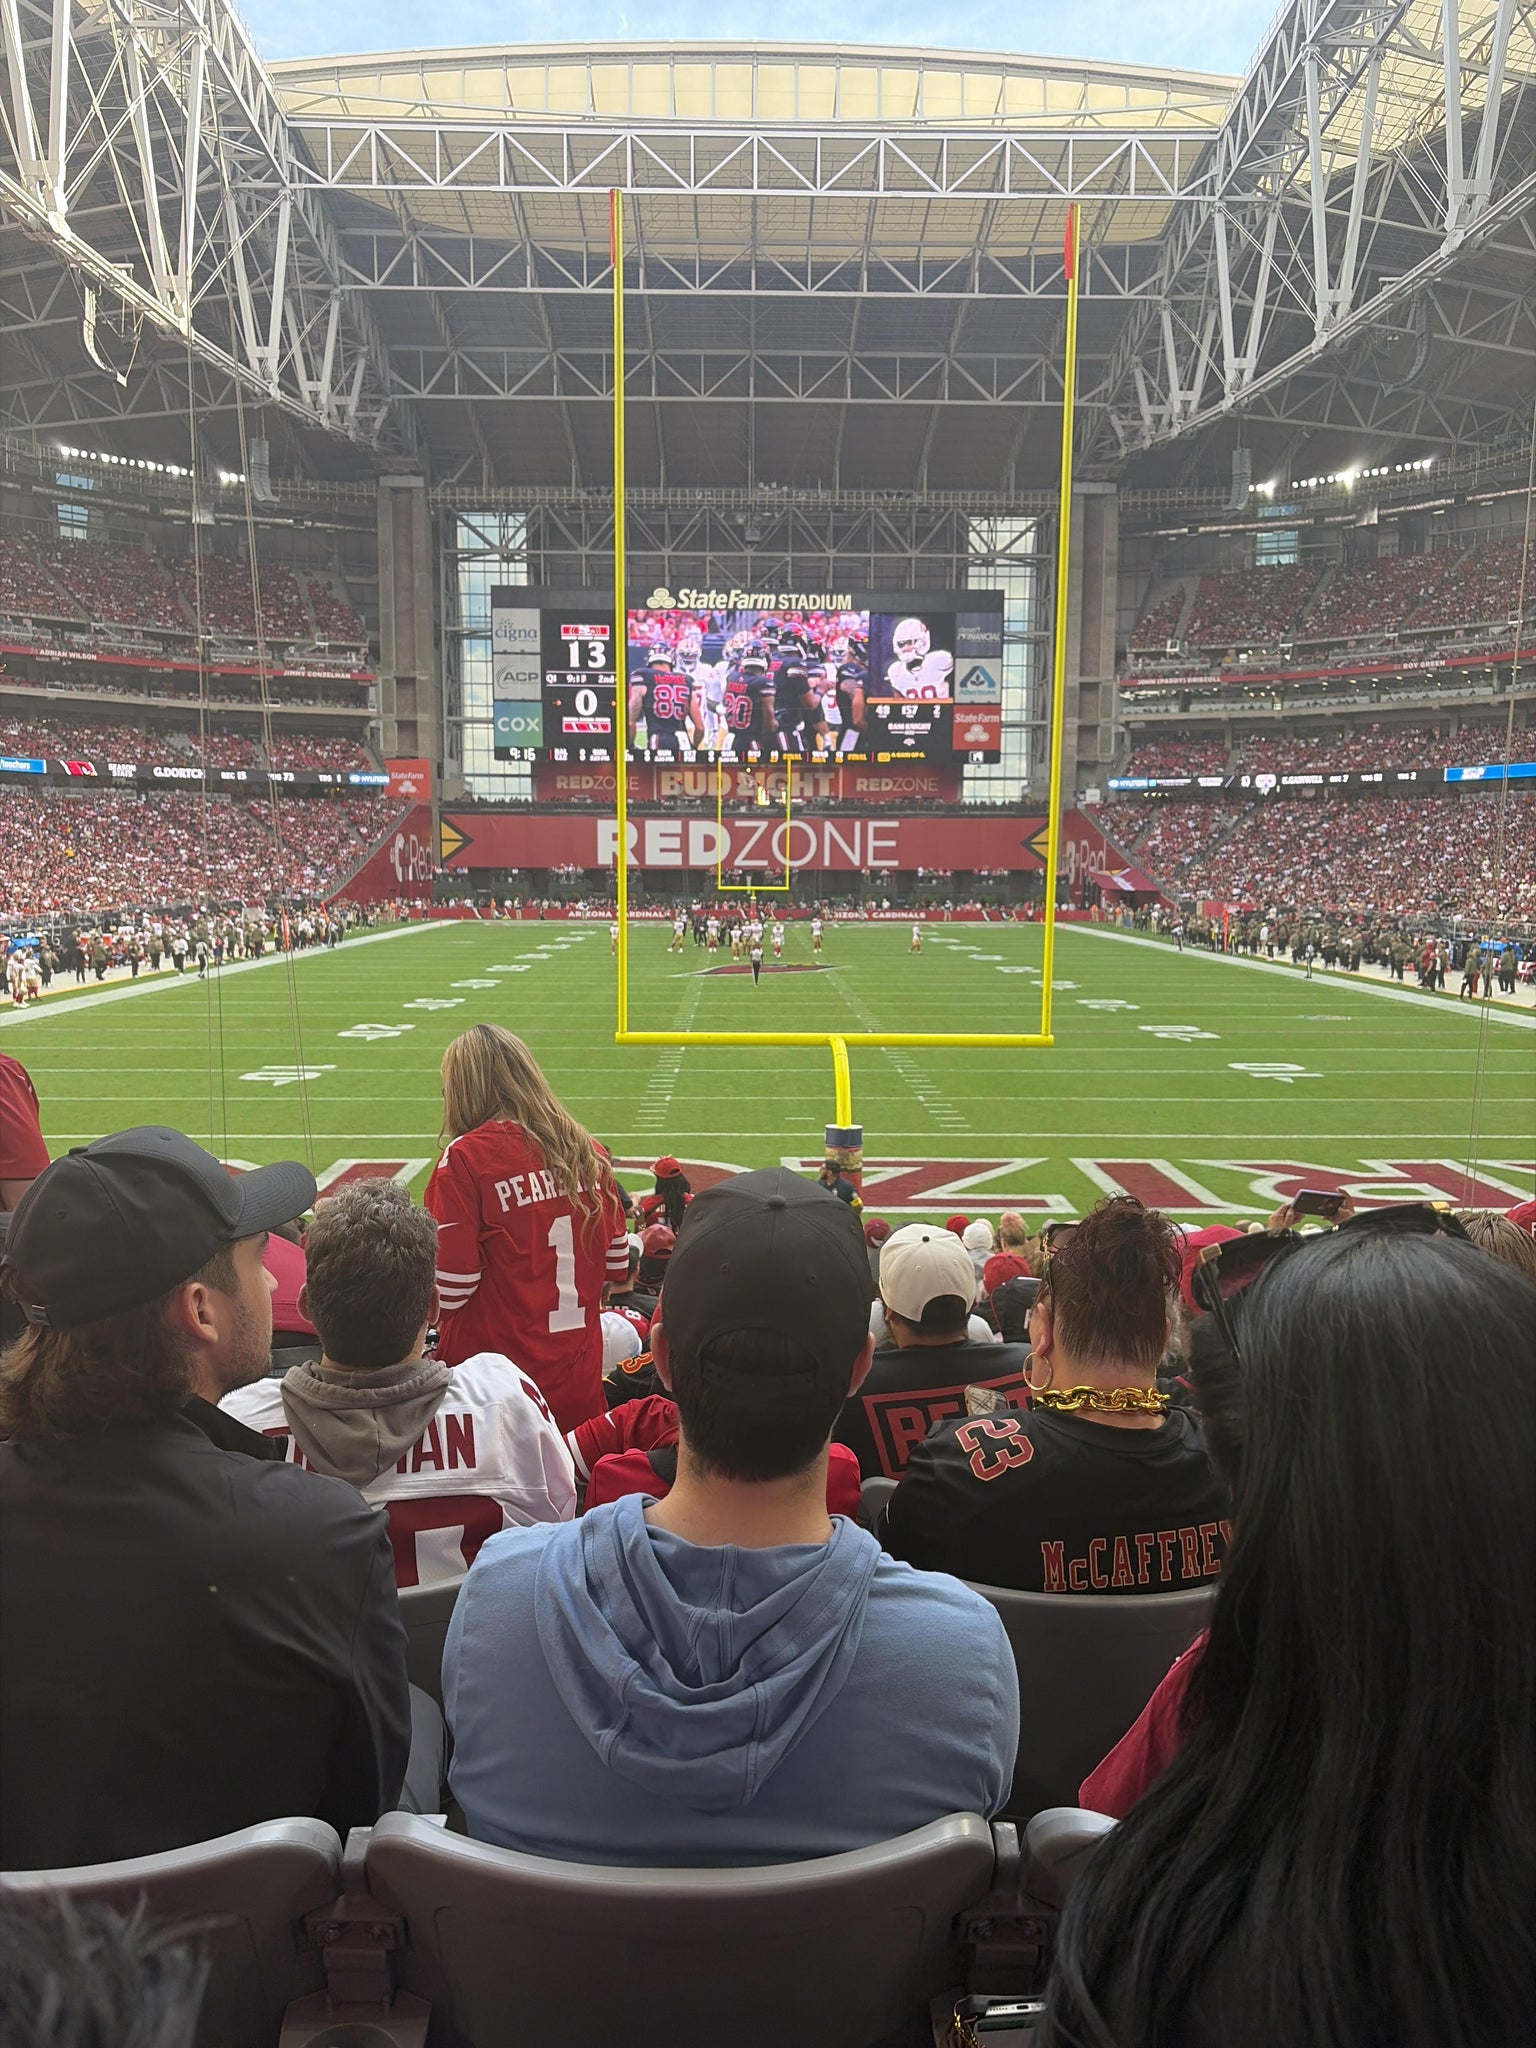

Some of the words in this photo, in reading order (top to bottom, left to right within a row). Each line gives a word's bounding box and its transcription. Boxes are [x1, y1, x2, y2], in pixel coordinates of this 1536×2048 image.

[778, 595, 852, 610] STADIUM
[495, 625, 538, 641] cigna
[40, 649, 68, 658] ADRIAN
[69, 652, 97, 660] WILSON
[568, 640, 606, 668] 13
[1403, 662, 1418, 670] ROY
[1420, 660, 1446, 668] GREEN
[284, 669, 306, 677] JIMMY
[503, 672, 539, 682] ACP
[546, 674, 557, 683] Q1
[598, 674, 615, 684] 2nd
[575, 689, 598, 717] 0
[653, 684, 690, 721] 85
[497, 717, 540, 732] COX
[108, 763, 137, 771] SEASON
[153, 766, 205, 778] G.DORTCH
[361, 775, 390, 783] HYUNDAI
[556, 774, 639, 792] REDZOE
[660, 771, 732, 796] BUD
[856, 777, 939, 792] REDZONE
[597, 818, 900, 867] REDZONE
[568, 910, 612, 918] ARZONA
[616, 910, 668, 918] RDINAL
[872, 911, 926, 919] CARDINALS
[494, 1166, 602, 1213] PEAR
[548, 1215, 586, 1333] 1
[955, 1418, 1035, 1482] 23
